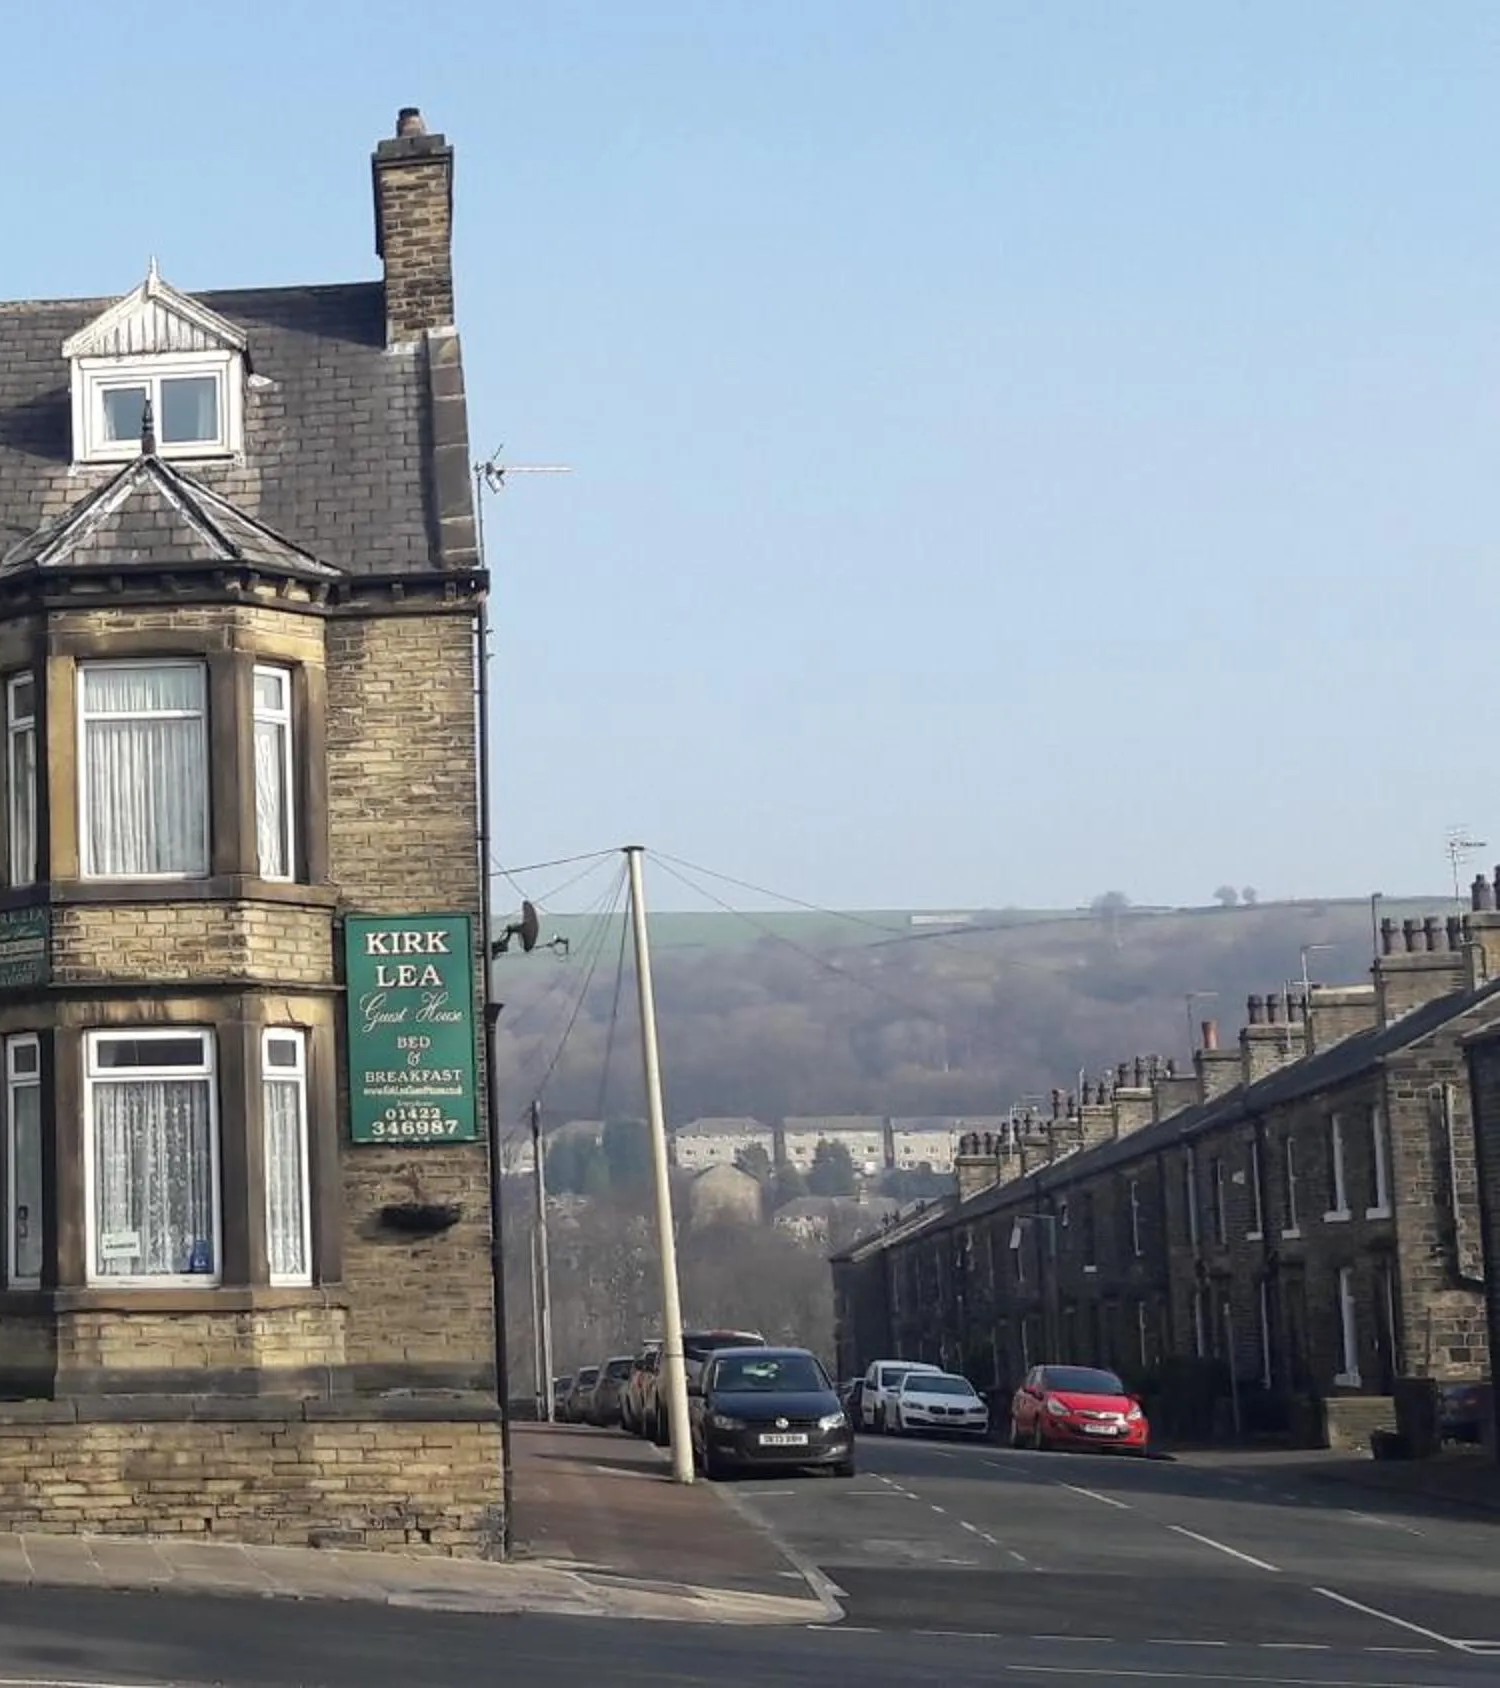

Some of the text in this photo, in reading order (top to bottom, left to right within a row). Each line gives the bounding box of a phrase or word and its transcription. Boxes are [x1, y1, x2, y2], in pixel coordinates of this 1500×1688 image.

[365, 931, 450, 954] KIRK
[376, 964, 443, 987] LEA
[360, 991, 462, 1033] Guest House
[396, 1035, 431, 1050] BED
[407, 1051, 421, 1067] &
[365, 1069, 463, 1083] BREAKFAST
[385, 1107, 441, 1120] 01422
[372, 1119, 459, 1136] 346987
